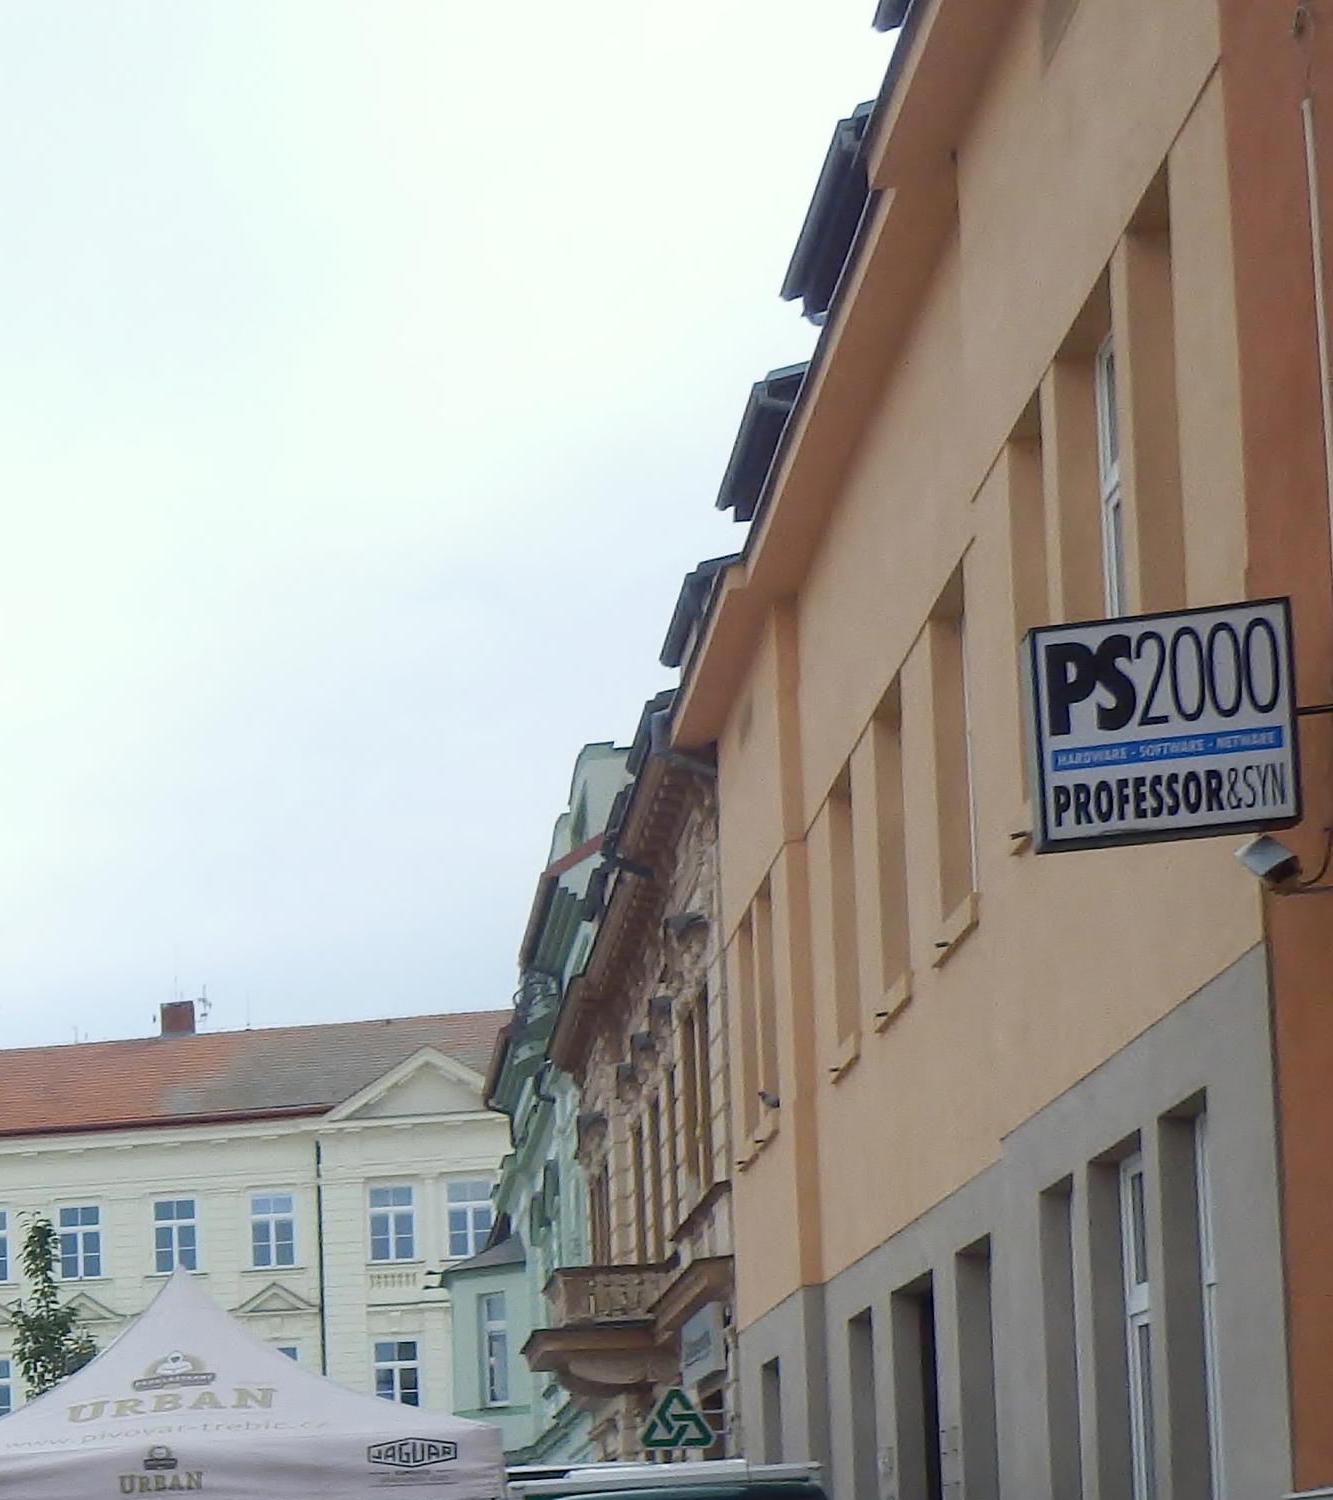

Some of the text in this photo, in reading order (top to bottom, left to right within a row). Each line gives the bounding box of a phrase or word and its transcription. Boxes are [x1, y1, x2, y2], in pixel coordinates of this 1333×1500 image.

[1044, 617, 1280, 736] PS2000
[1056, 742, 1127, 766] HARDWARE
[1139, 734, 1205, 759] SOFTWARE
[1053, 761, 1286, 827] PROFESSOR&SYN
[66, 1388, 278, 1423] URBAN
[372, 1441, 453, 1464] JAGUAR
[119, 1471, 204, 1494] URBAN
